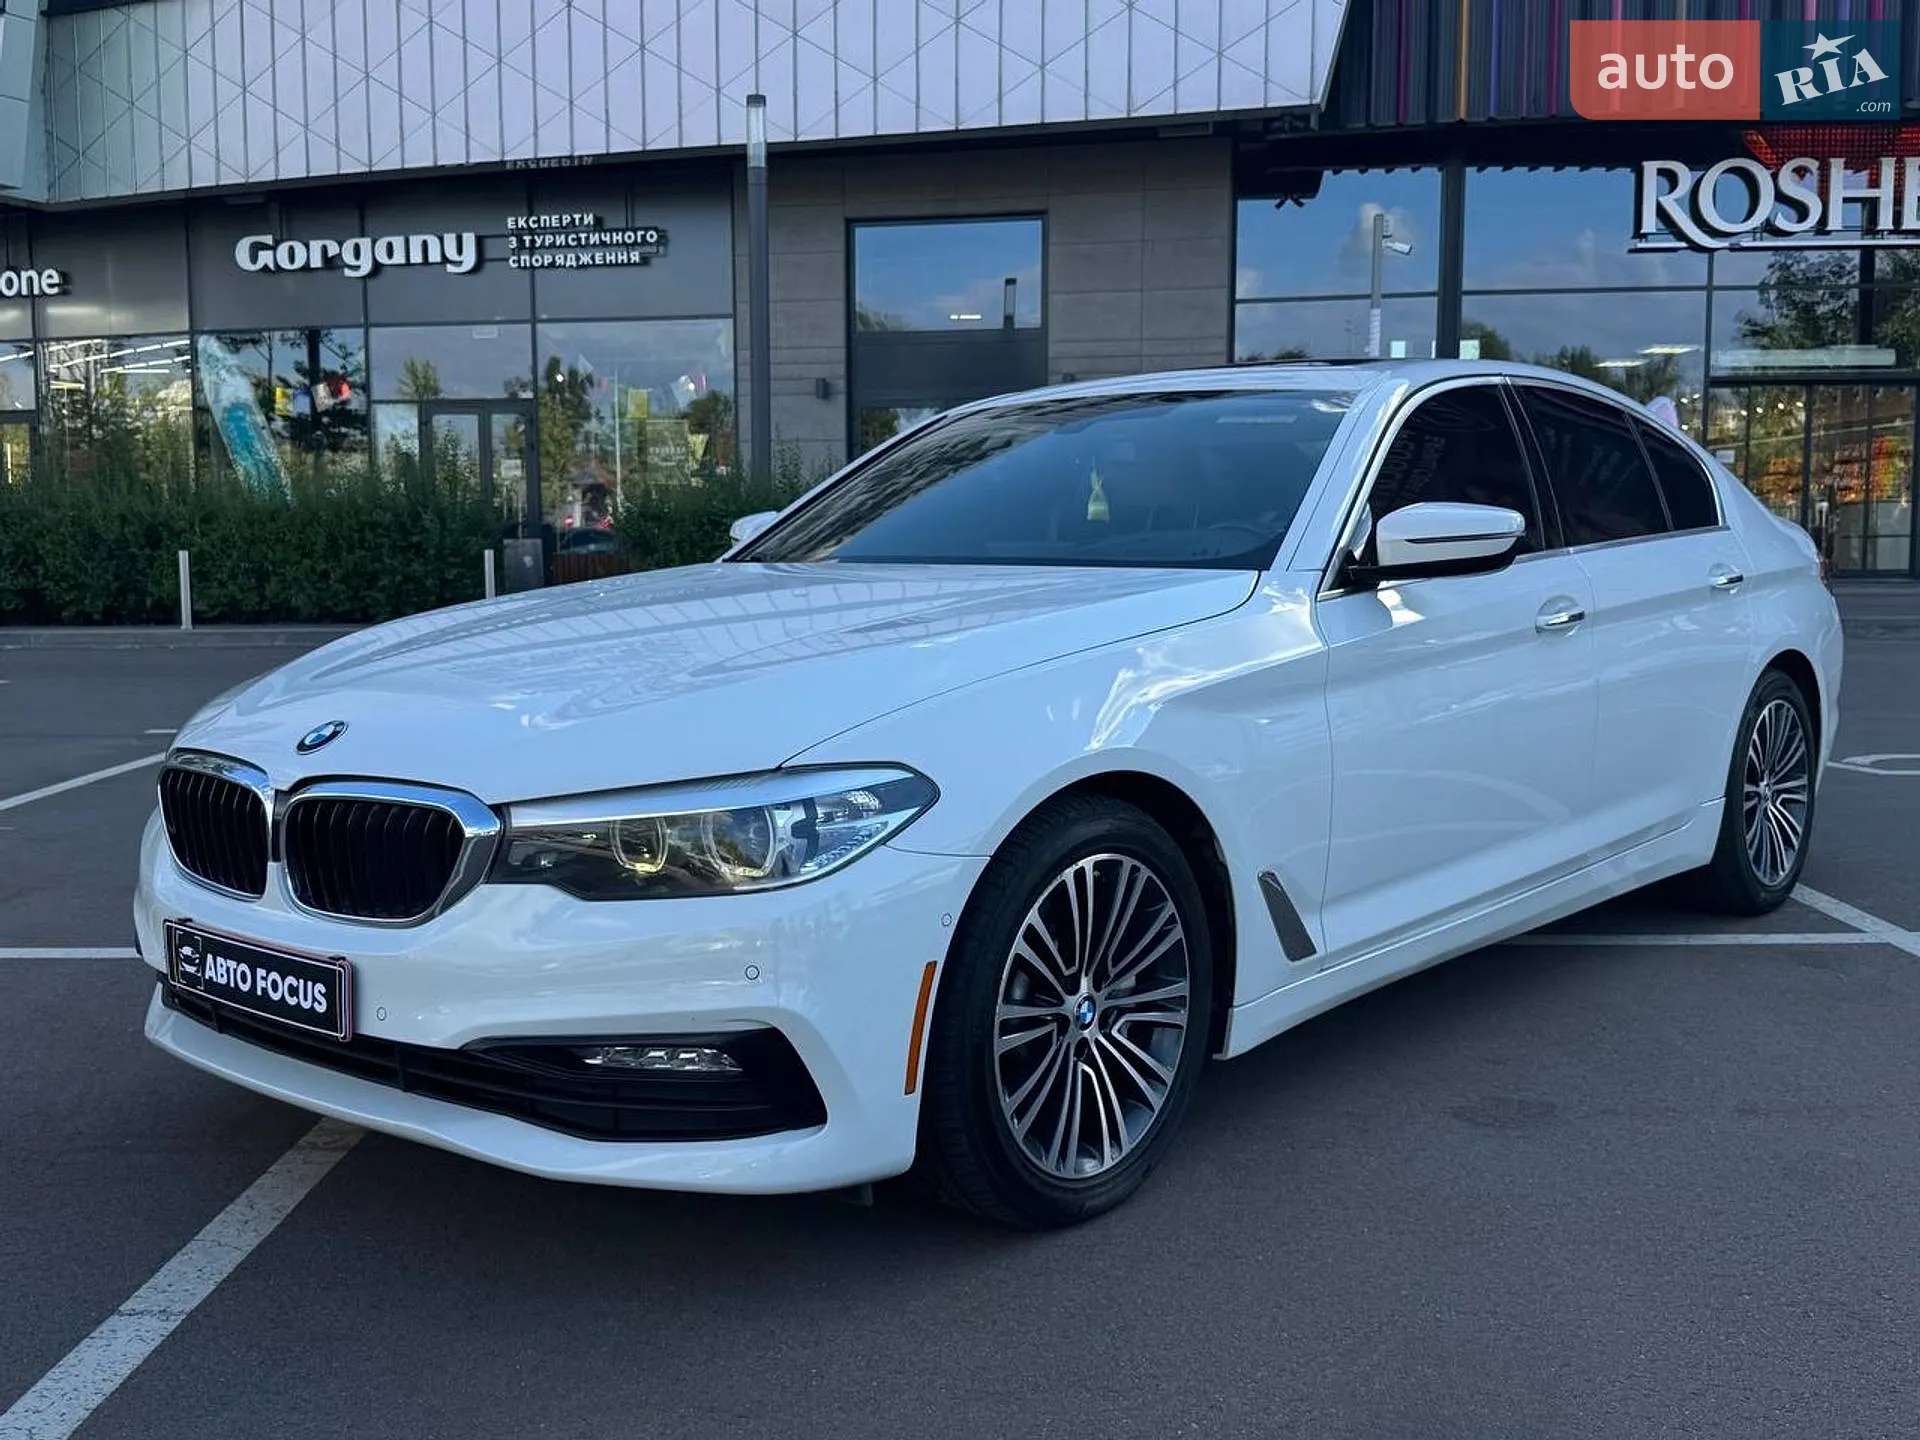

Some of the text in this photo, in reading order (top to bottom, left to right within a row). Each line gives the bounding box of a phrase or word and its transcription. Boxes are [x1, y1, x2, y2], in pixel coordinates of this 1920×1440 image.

[506, 212, 595, 230] ЕКСПЕРТИ
[522, 230, 659, 248] ТУРИСТИЧНОГО
[234, 231, 477, 278] Gorgany
[508, 251, 641, 269] СПОРЯДЖЕННЯ
[0, 268, 60, 297] one
[204, 952, 328, 1013] АВТО FOCUS
